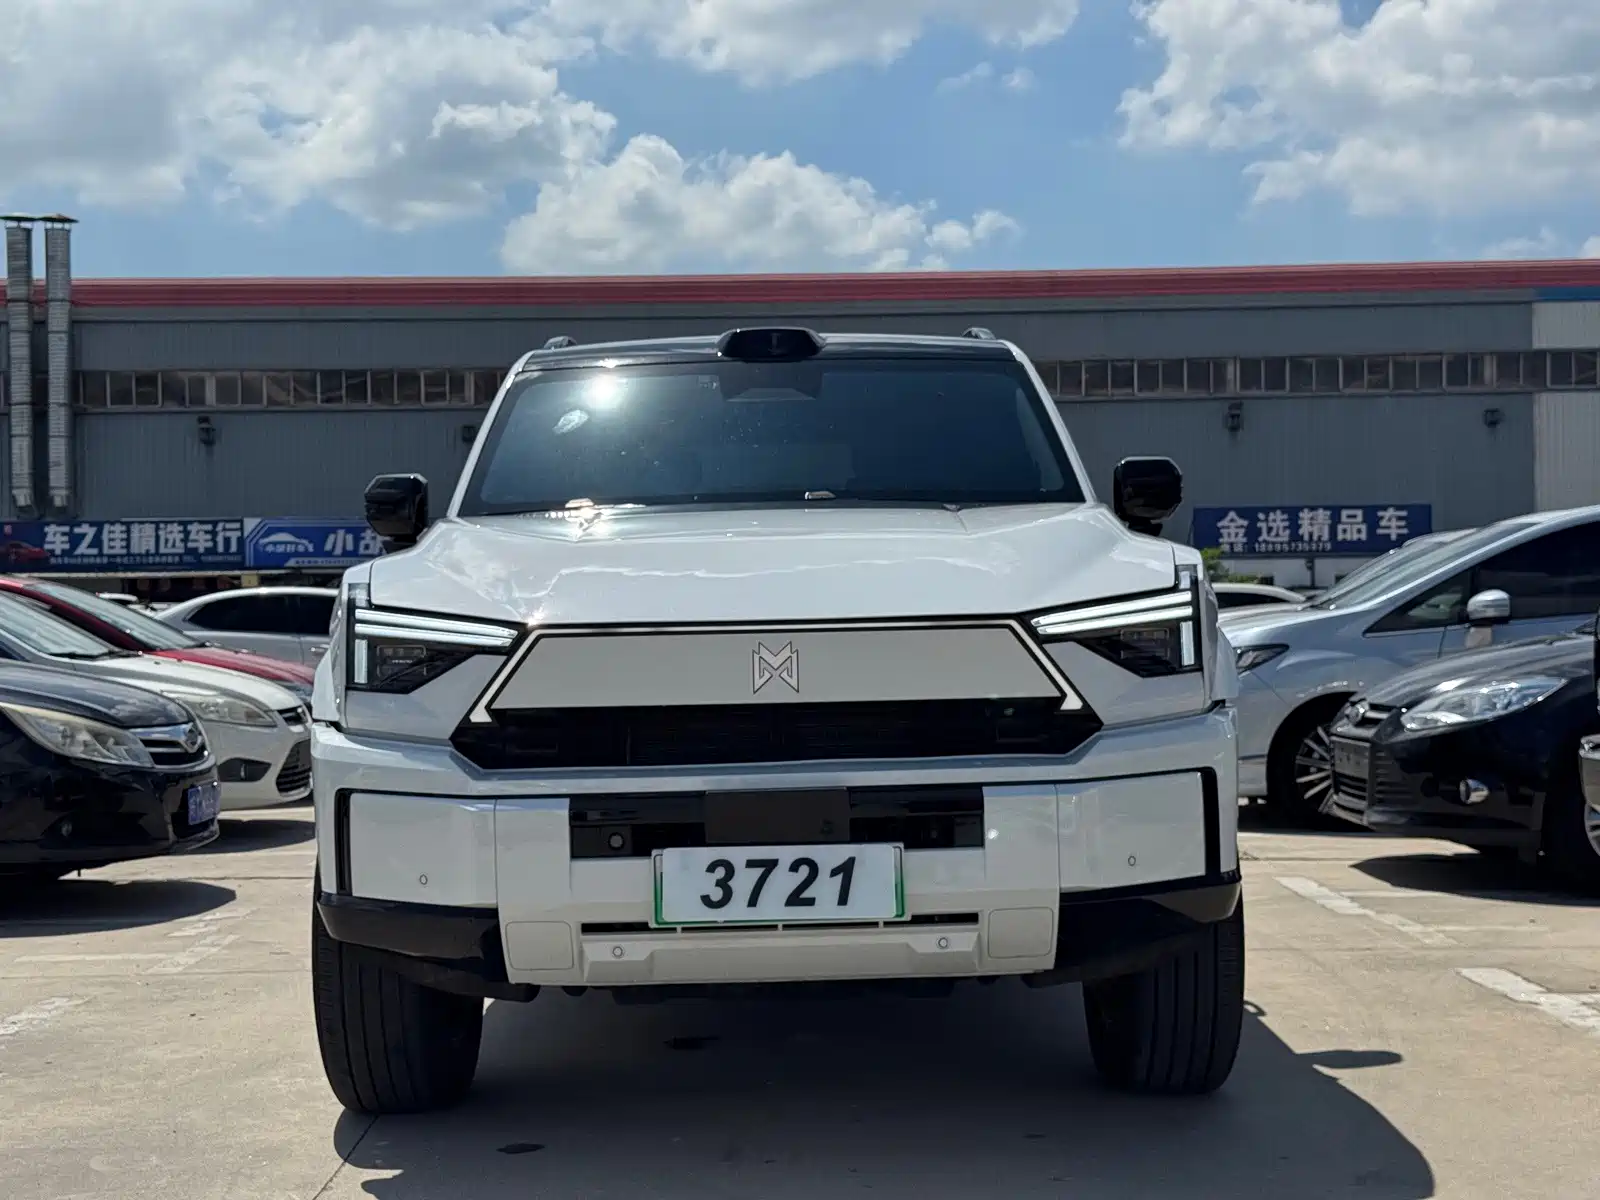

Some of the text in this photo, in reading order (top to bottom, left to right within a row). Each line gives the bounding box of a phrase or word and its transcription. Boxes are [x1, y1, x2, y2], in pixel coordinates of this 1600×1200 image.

[43, 522, 241, 555] 车之佳精选车行
[1217, 507, 1409, 543] 金选精品车
[699, 856, 857, 909] 3721
